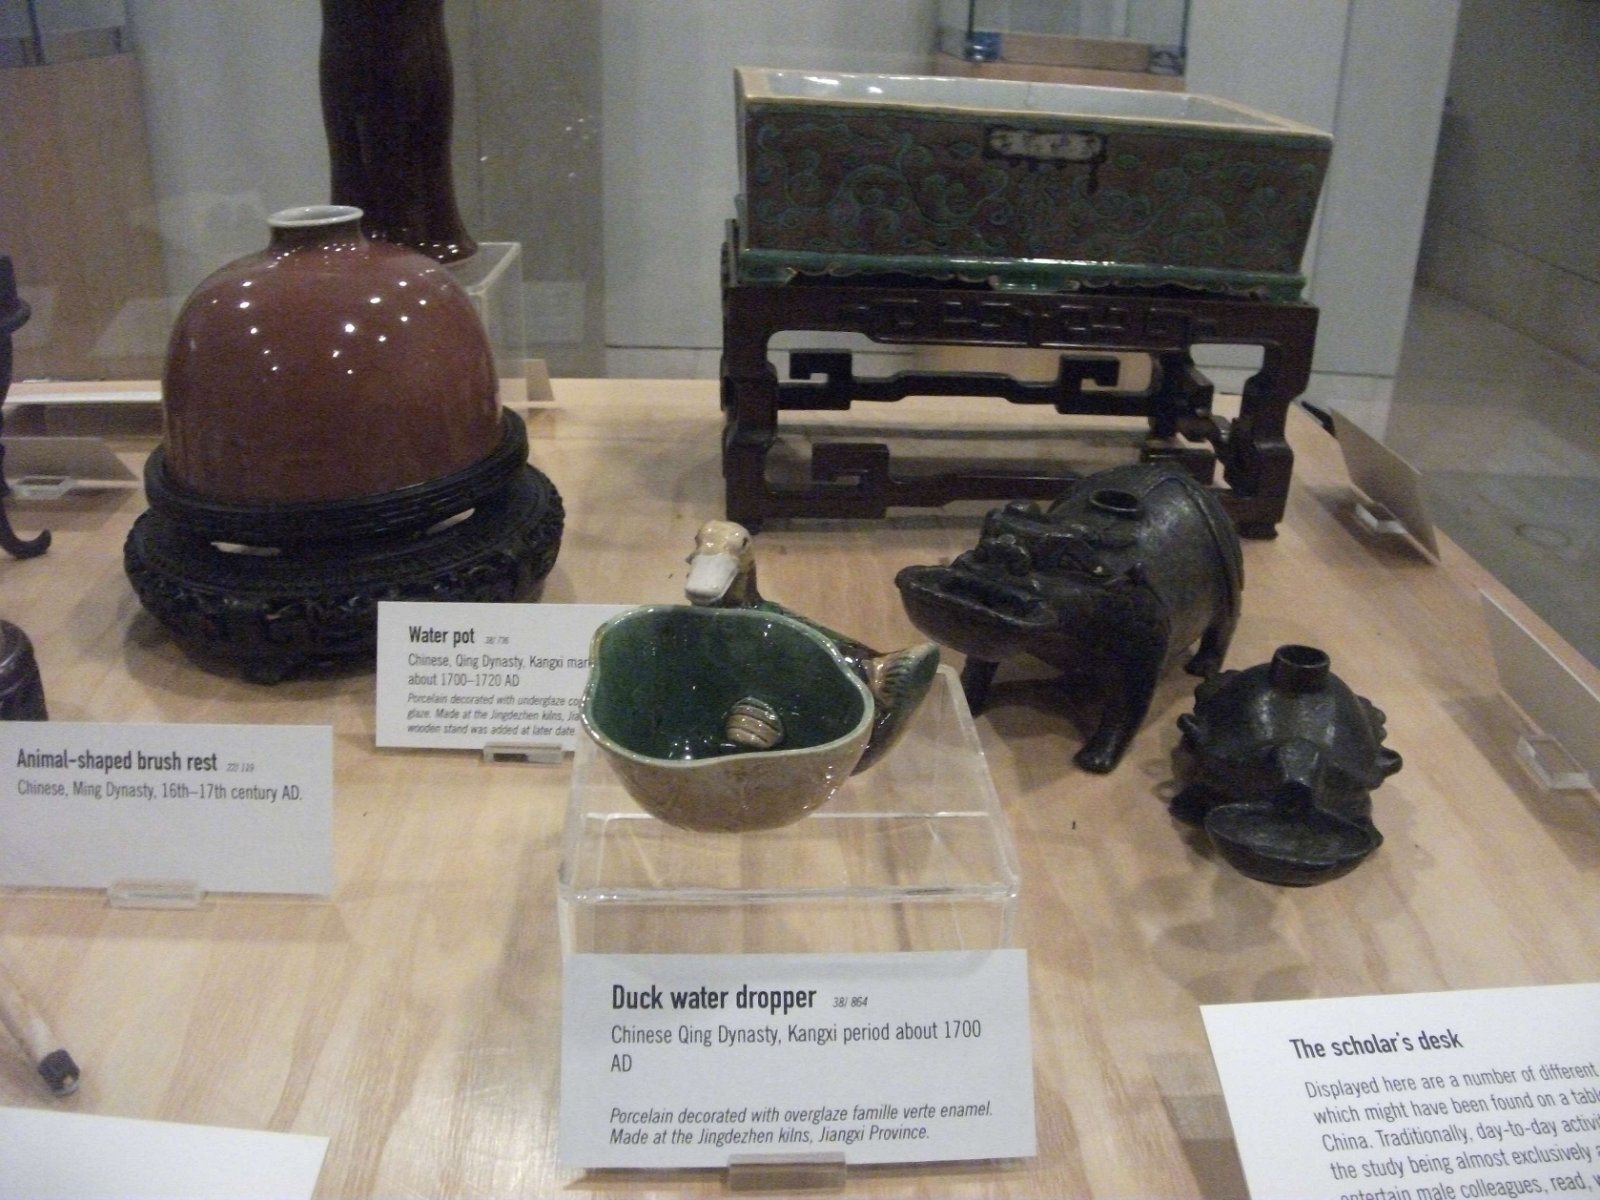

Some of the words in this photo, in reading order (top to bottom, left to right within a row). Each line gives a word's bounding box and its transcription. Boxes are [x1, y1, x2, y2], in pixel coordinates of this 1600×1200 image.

[409, 626, 447, 643] Water
[453, 628, 475, 647] pot
[408, 653, 452, 668] Chinese,
[456, 654, 478, 668] Qing
[482, 655, 524, 669] Dynasty,
[530, 656, 563, 670] Kangxi
[567, 658, 592, 668] mar
[408, 673, 437, 685] about
[504, 674, 519, 686] AD
[568, 698, 580, 707] co
[567, 712, 581, 721] Jia
[16, 749, 132, 774] Animal-shaped
[138, 751, 181, 770] brush
[187, 753, 218, 772] rest
[18, 780, 68, 797] Chinese,
[73, 782, 102, 798] Ming
[106, 782, 157, 800] Dynasty,
[230, 784, 278, 802] century
[282, 785, 302, 800] AD.
[612, 985, 663, 1010] Duck
[670, 986, 729, 1009] water
[736, 985, 817, 1014] dropper
[851, 997, 868, 1007] 864
[612, 1024, 672, 1044] Chinese
[678, 1024, 712, 1047] Qing
[719, 1024, 782, 1046] Dynasty,
[788, 1023, 837, 1043] Kangxi
[843, 1021, 890, 1044] period
[895, 1021, 938, 1040] about
[944, 1020, 981, 1039] 1700
[1290, 1038, 1326, 1059] The
[1331, 1032, 1414, 1056] scholar's
[1418, 1029, 1464, 1050] desk
[611, 1054, 632, 1072] AD
[1305, 1077, 1380, 1100] Displayed
[1382, 1076, 1417, 1093] here
[1421, 1077, 1445, 1090] are
[1450, 1075, 1460, 1088] a
[1463, 1066, 1517, 1087] number
[1521, 1066, 1536, 1082] of
[1539, 1062, 1599, 1081] different
[610, 1106, 673, 1124] Porcelain
[678, 1106, 746, 1124] decorated
[751, 1106, 779, 1122] with
[784, 1106, 847, 1125] overglaze
[852, 1104, 898, 1122] famille
[903, 1104, 934, 1119] verte
[940, 1101, 992, 1118] enamel.
[1314, 1105, 1360, 1125] which
[1365, 1100, 1409, 1123] might
[1413, 1099, 1448, 1117] have
[1451, 1096, 1487, 1114] been
[1490, 1092, 1533, 1111] found
[1537, 1094, 1555, 1107] on
[1560, 1092, 1570, 1106] a
[610, 1130, 648, 1145] Made
[653, 1130, 668, 1145] at
[672, 1129, 692, 1144] the
[697, 1128, 774, 1148] Jingdezhen
[778, 1127, 813, 1145] kilns,
[818, 1125, 865, 1147] Jiangxi
[869, 1124, 929, 1141] Province.
[1322, 1132, 1374, 1153] China.
[1375, 1124, 1474, 1148] Traditionally,
[1477, 1117, 1558, 1141] day-to-day
[1330, 1161, 1358, 1180] the
[1362, 1155, 1404, 1178] study
[1407, 1154, 1454, 1174] being
[1456, 1149, 1507, 1170] almost
[1512, 1141, 1593, 1165] exclusively
[1416, 1182, 1455, 1200] male
[1460, 1176, 1548, 1200] colleagues,
[1550, 1172, 1593, 1192] read,
